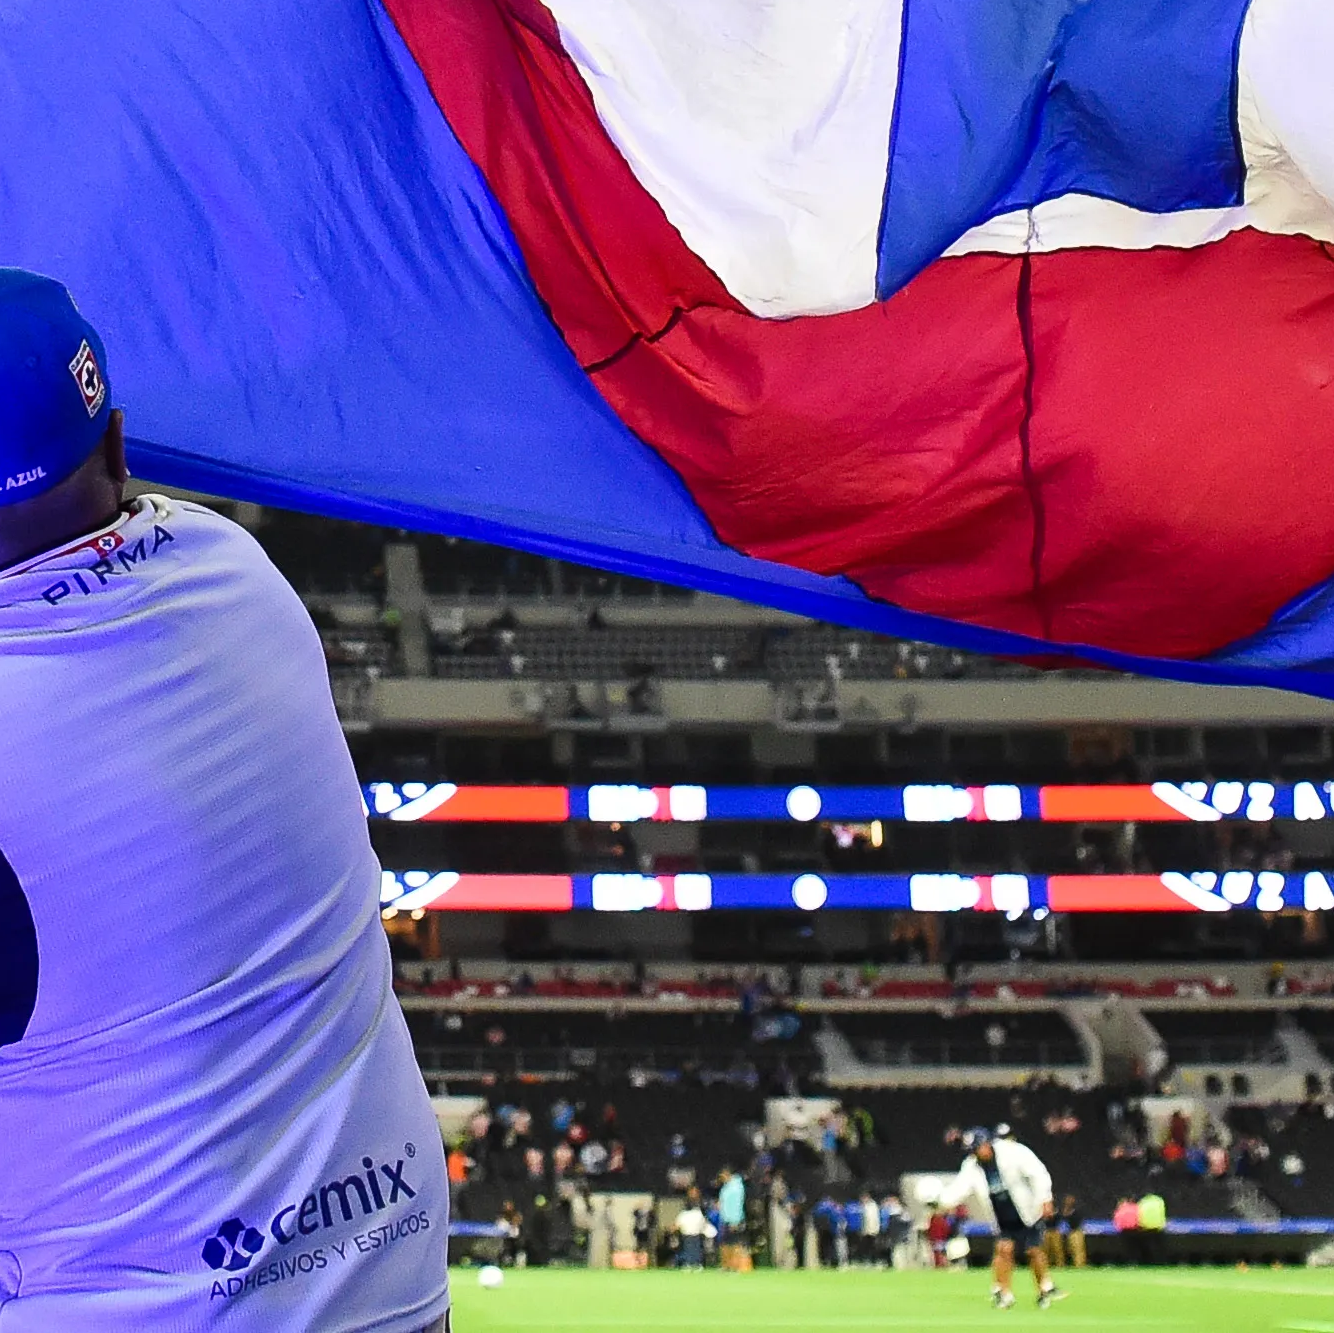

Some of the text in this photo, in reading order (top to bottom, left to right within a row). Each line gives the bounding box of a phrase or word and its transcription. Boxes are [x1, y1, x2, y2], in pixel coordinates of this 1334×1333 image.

[6, 465, 47, 491] AZUL
[41, 524, 175, 606] PIRMA
[209, 1210, 430, 1301] ADHESIVOS Y ESTUCOS
